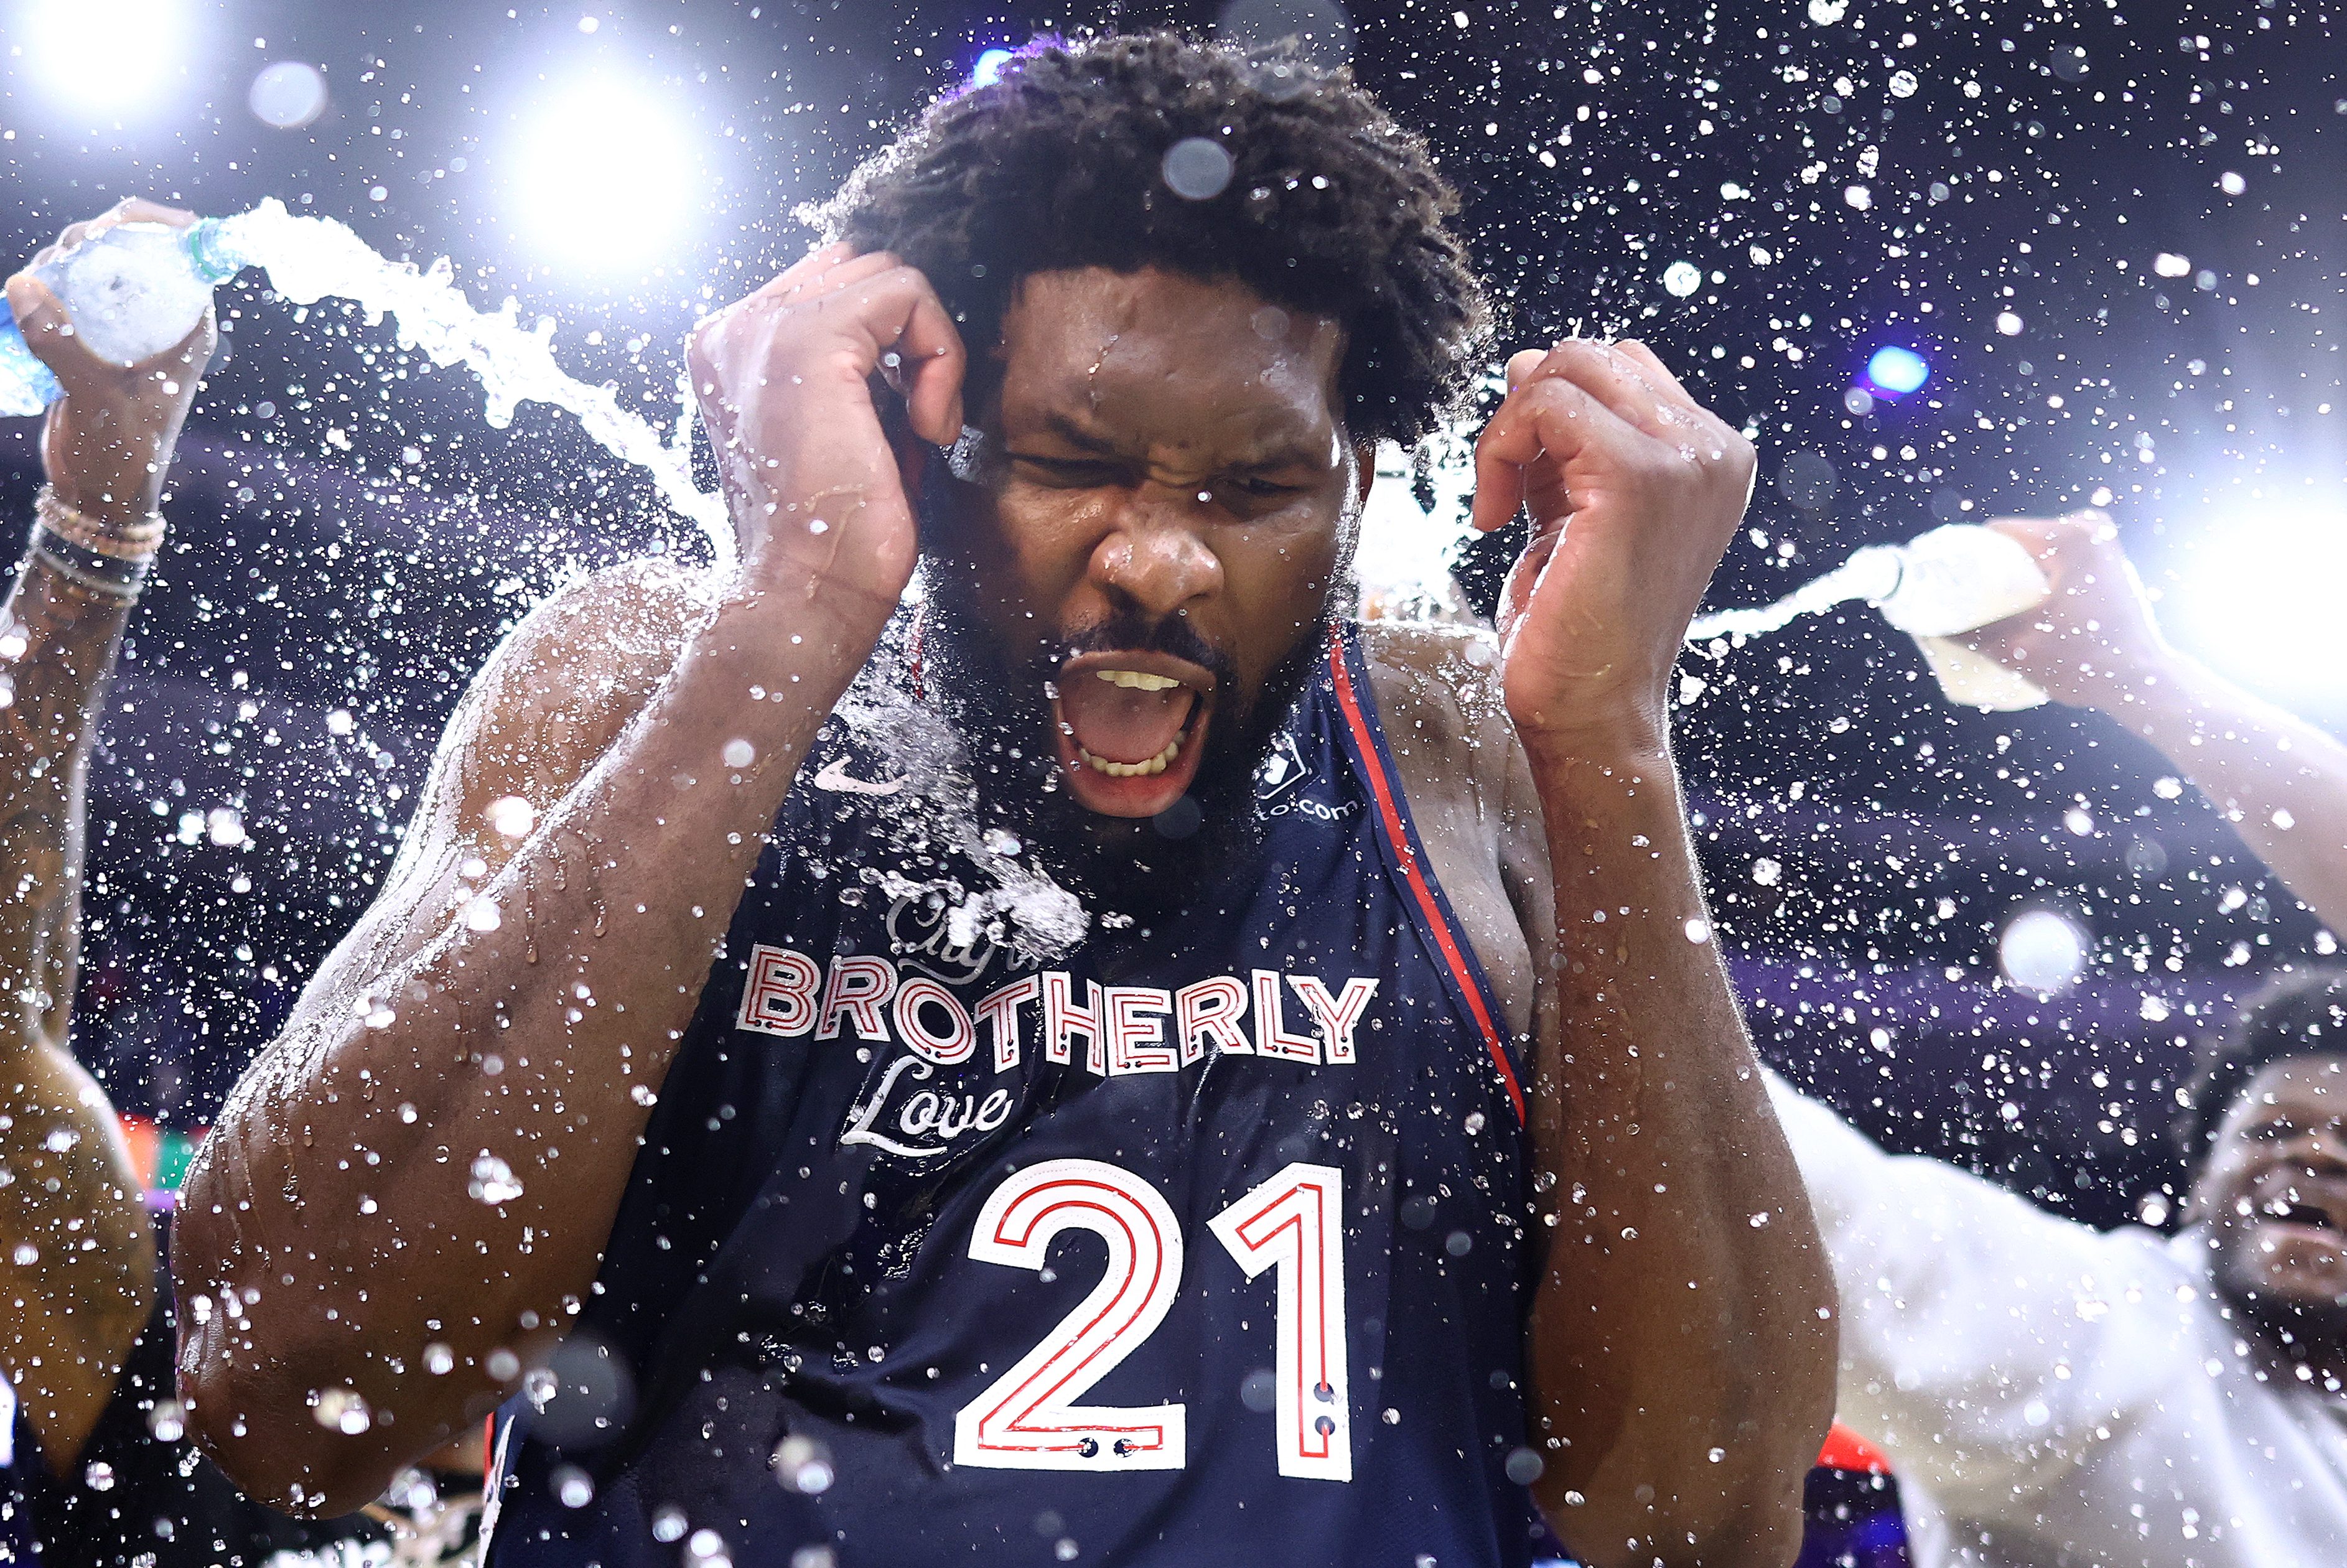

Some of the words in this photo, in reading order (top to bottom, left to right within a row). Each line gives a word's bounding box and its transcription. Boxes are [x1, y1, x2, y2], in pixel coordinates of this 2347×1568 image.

[735, 943, 1379, 1077] BROTHERLY
[840, 1055, 1014, 1157] Love
[953, 1157, 1353, 1483] 21
